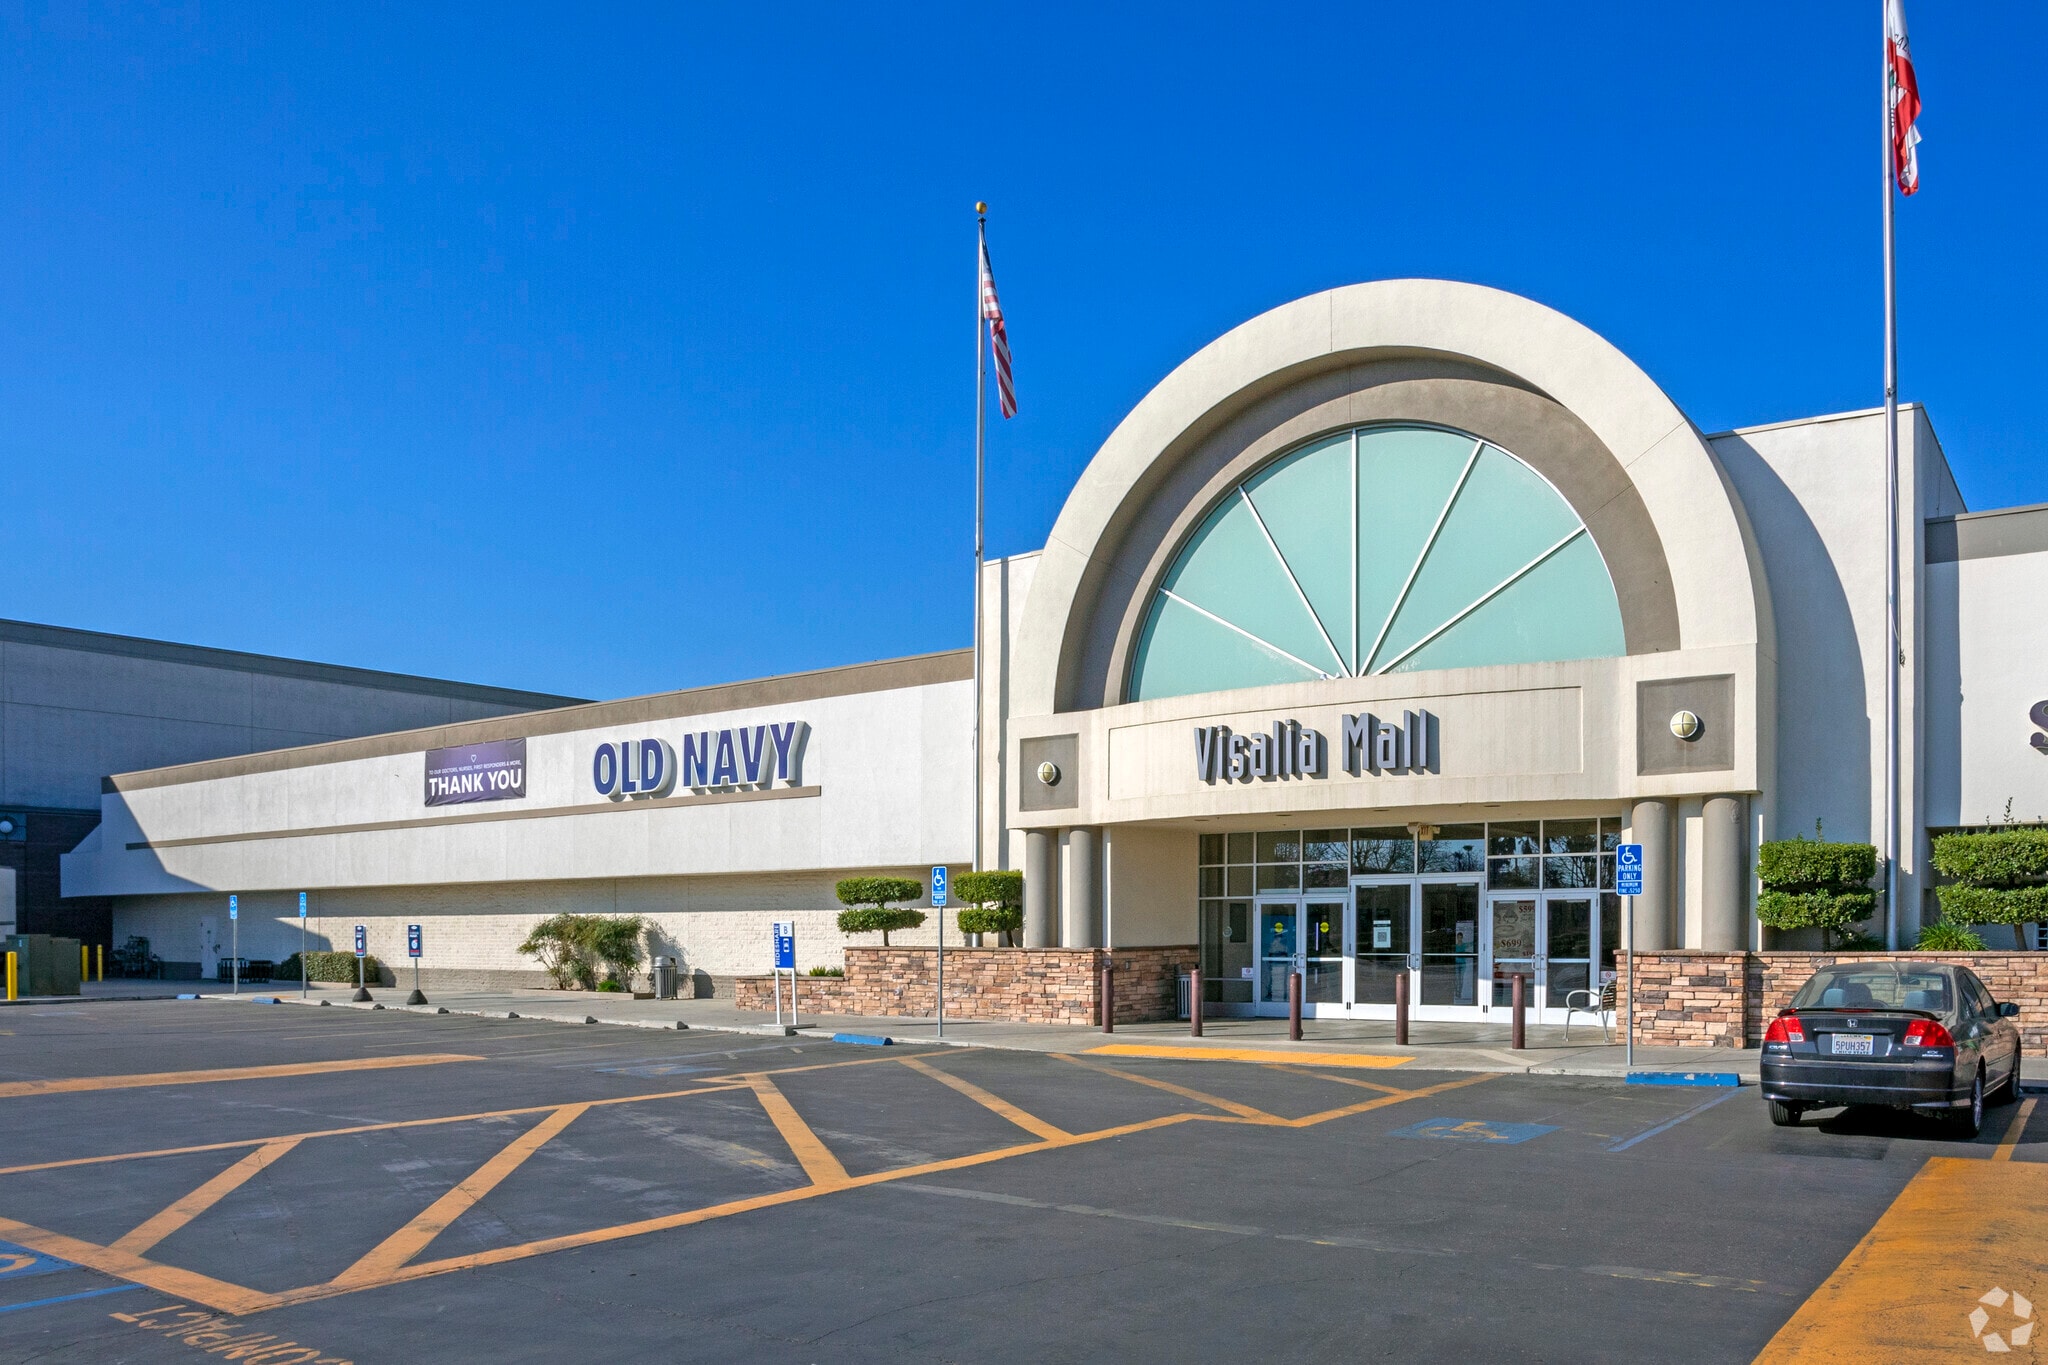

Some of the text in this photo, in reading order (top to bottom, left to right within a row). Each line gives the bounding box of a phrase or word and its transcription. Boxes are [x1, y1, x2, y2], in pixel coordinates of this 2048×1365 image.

[1194, 709, 1432, 781] Visalia Mall
[594, 720, 801, 796] OLD NAVY
[429, 768, 522, 797] THANK YOU
[1618, 864, 1642, 872] PARKING
[1622, 872, 1637, 880] ONLY
[783, 925, 788, 935] B
[1500, 939, 1522, 948] $699
[1835, 1040, 1871, 1051] 5PUH357
